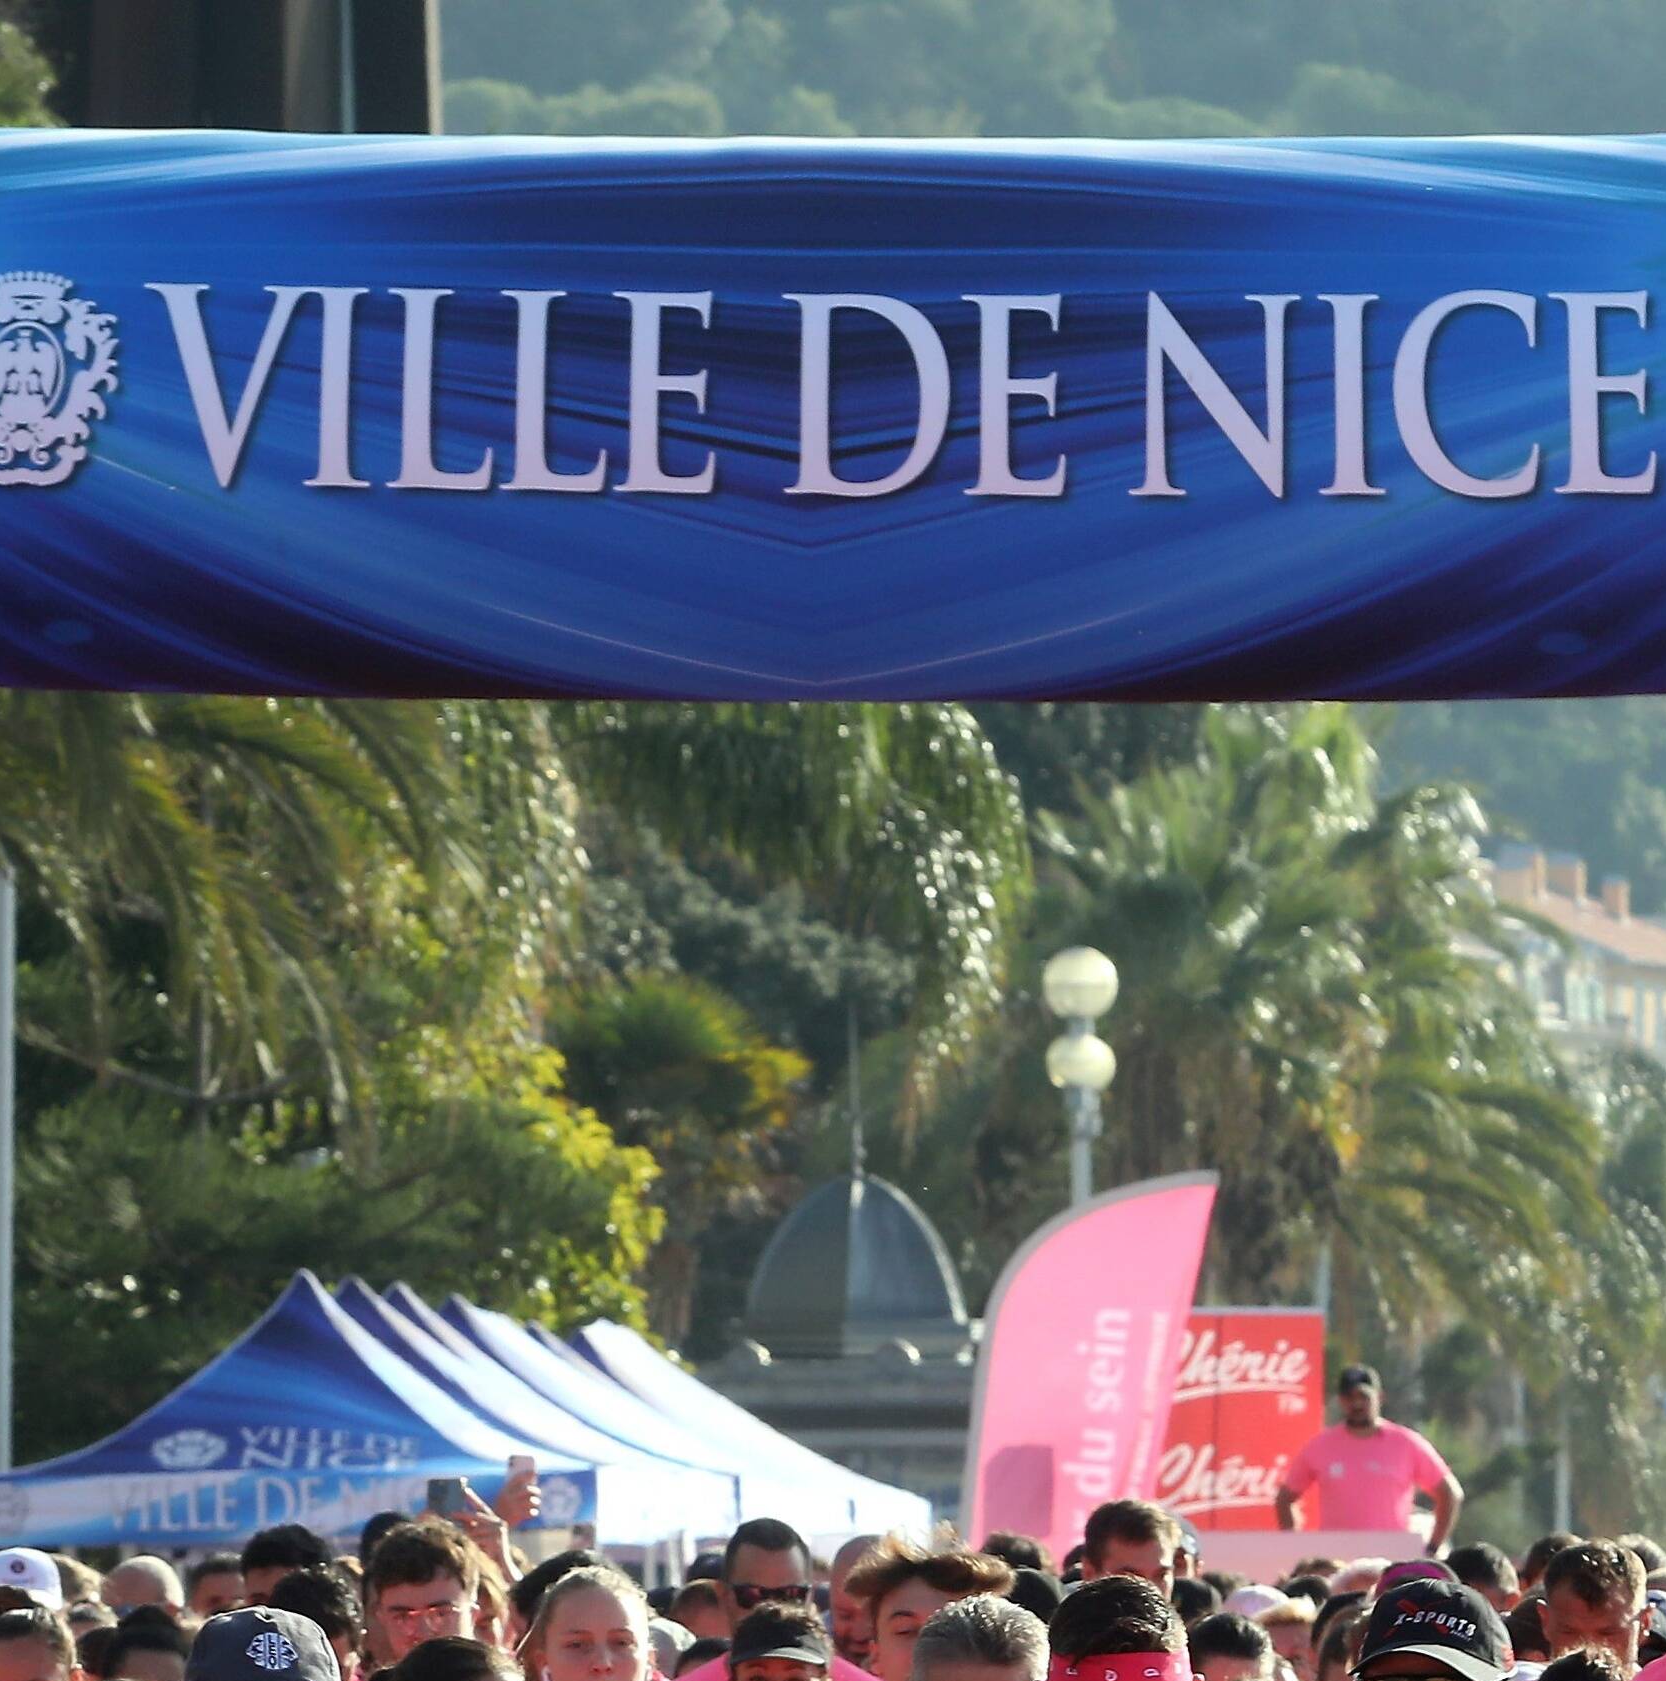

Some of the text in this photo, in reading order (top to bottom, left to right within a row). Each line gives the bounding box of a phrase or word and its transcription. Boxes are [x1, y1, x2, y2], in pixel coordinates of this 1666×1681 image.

[145, 281, 1660, 500] VILLE DE NICE
[1062, 1308, 1130, 1497] du sein
[1159, 1443, 1288, 1504] Chéri
[110, 1481, 238, 1533] VILLE
[1393, 1610, 1477, 1637] X-SPORTS
